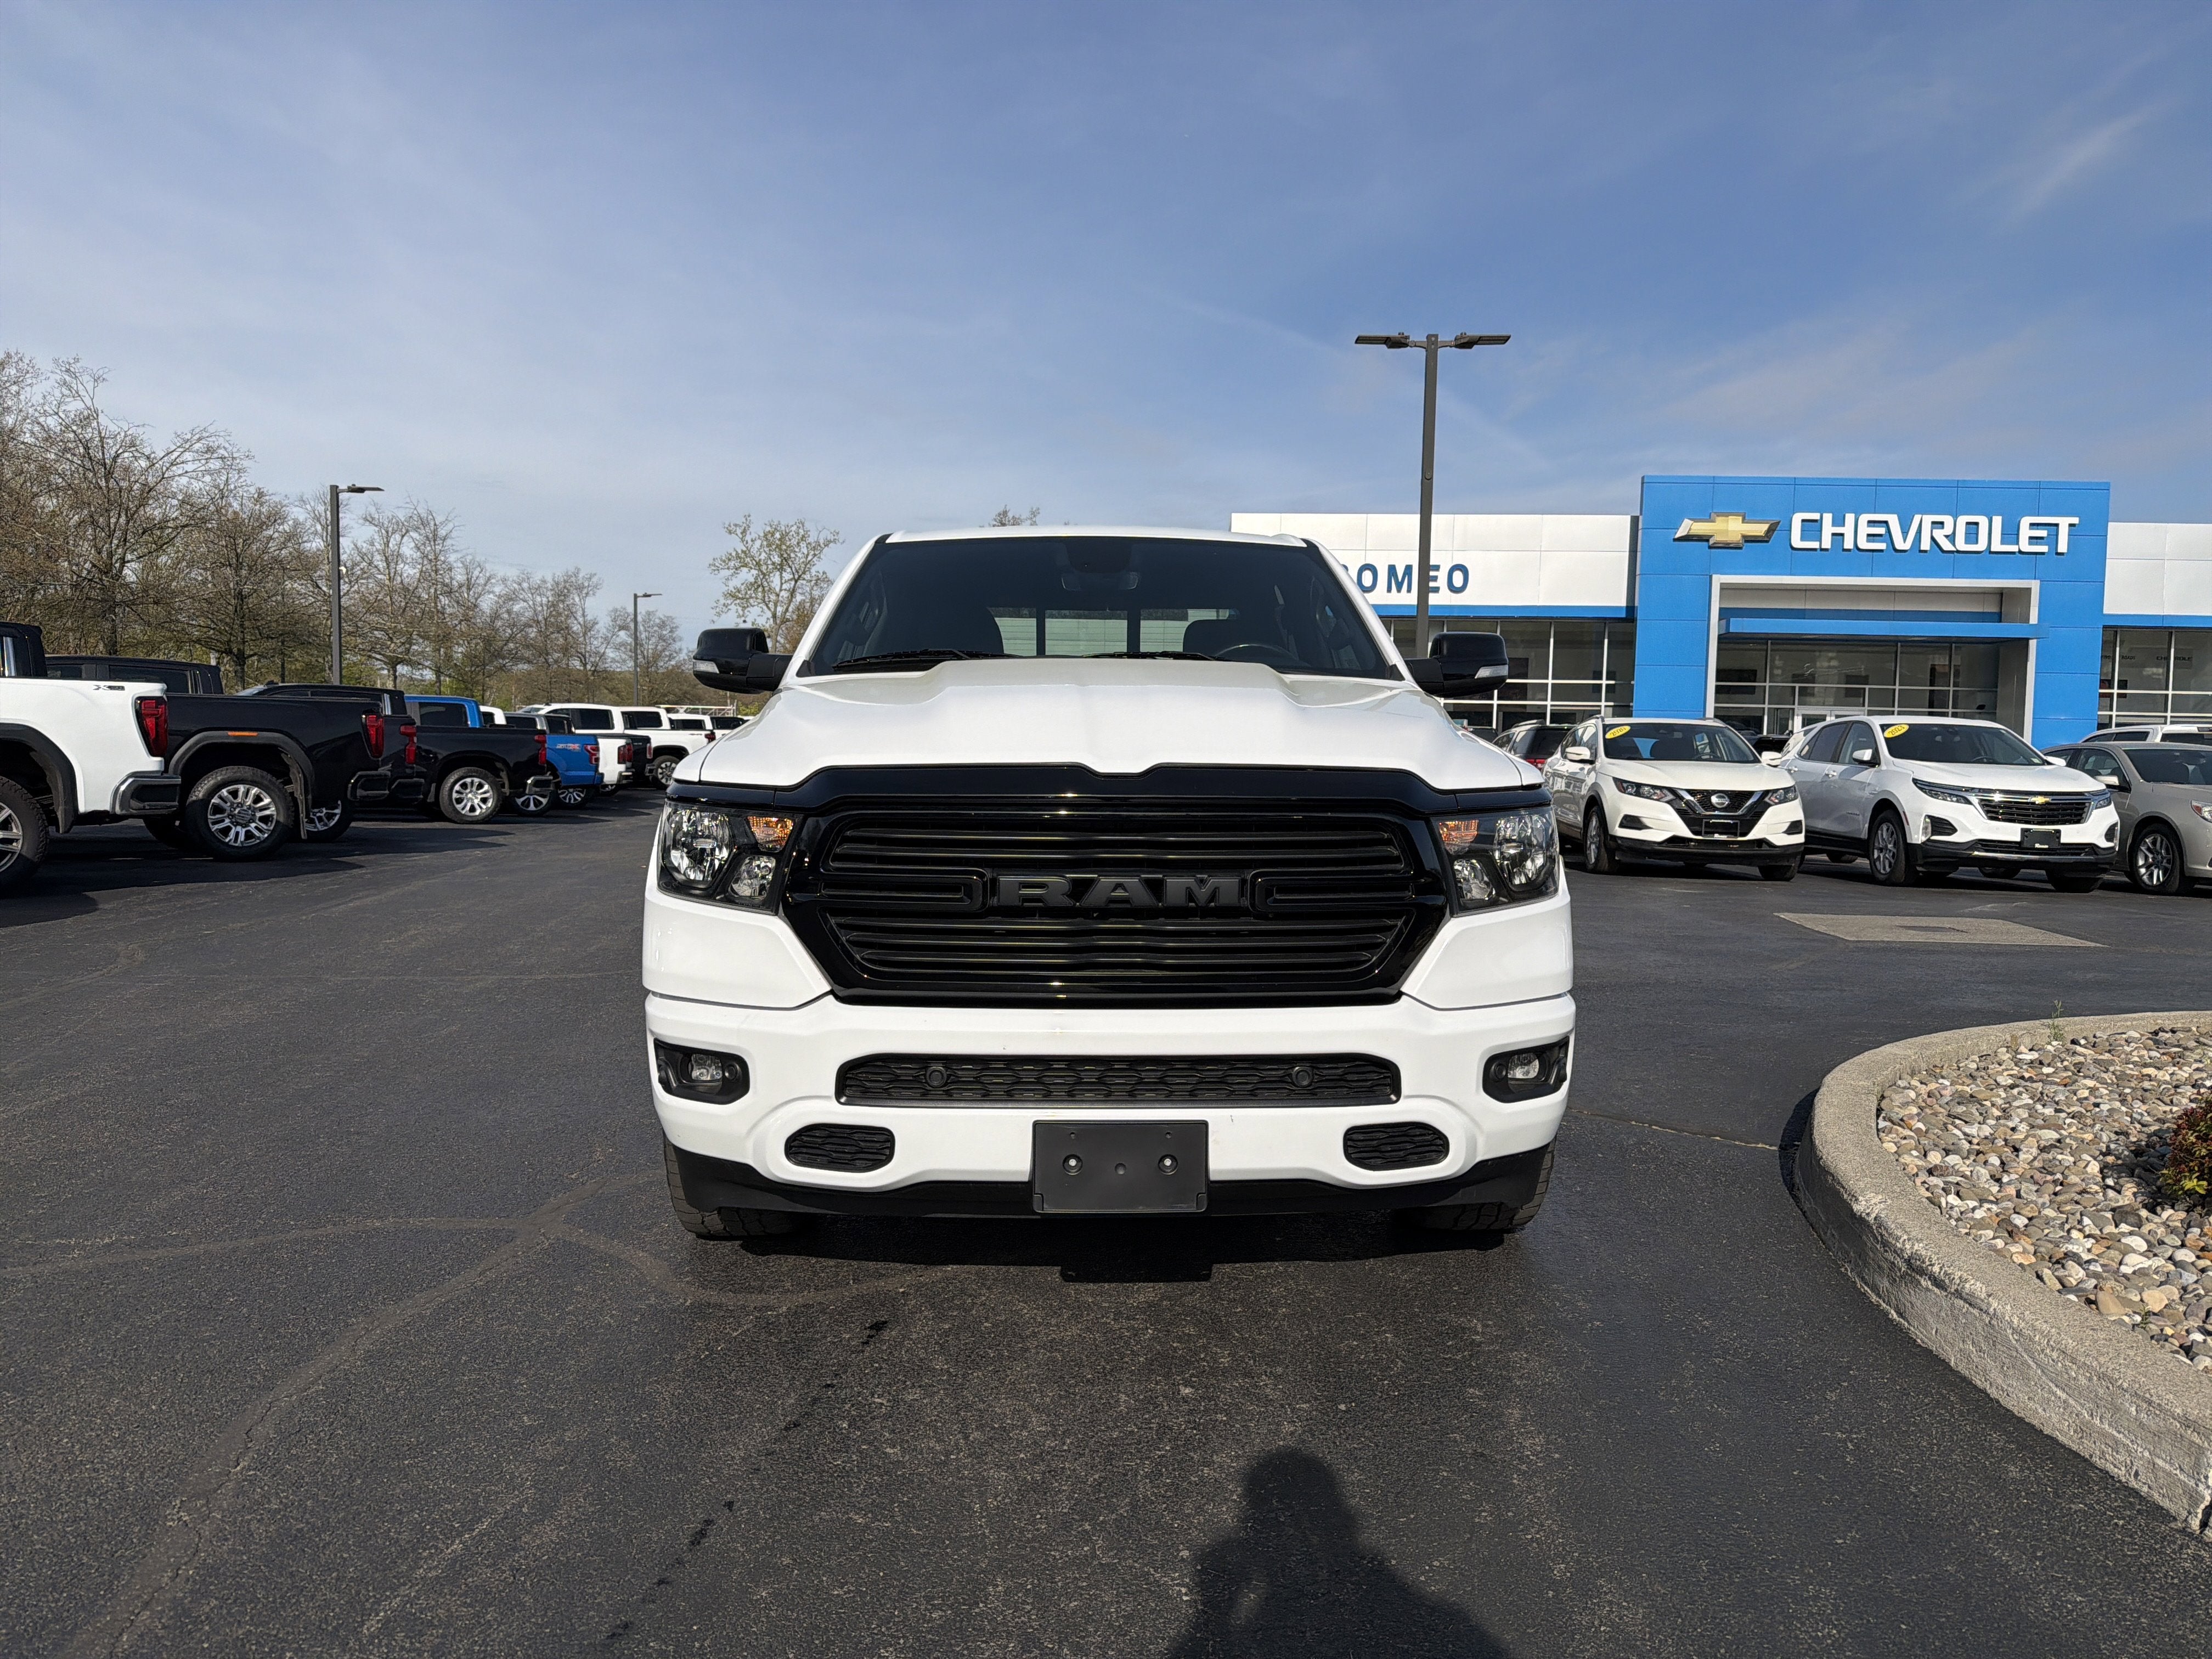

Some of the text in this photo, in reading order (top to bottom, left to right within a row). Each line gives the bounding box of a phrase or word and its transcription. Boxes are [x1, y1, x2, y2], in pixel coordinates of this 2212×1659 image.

[1791, 512, 2079, 554] CHEVROLET
[1342, 563, 1469, 594] OMEO
[997, 877, 1242, 906] RAM
